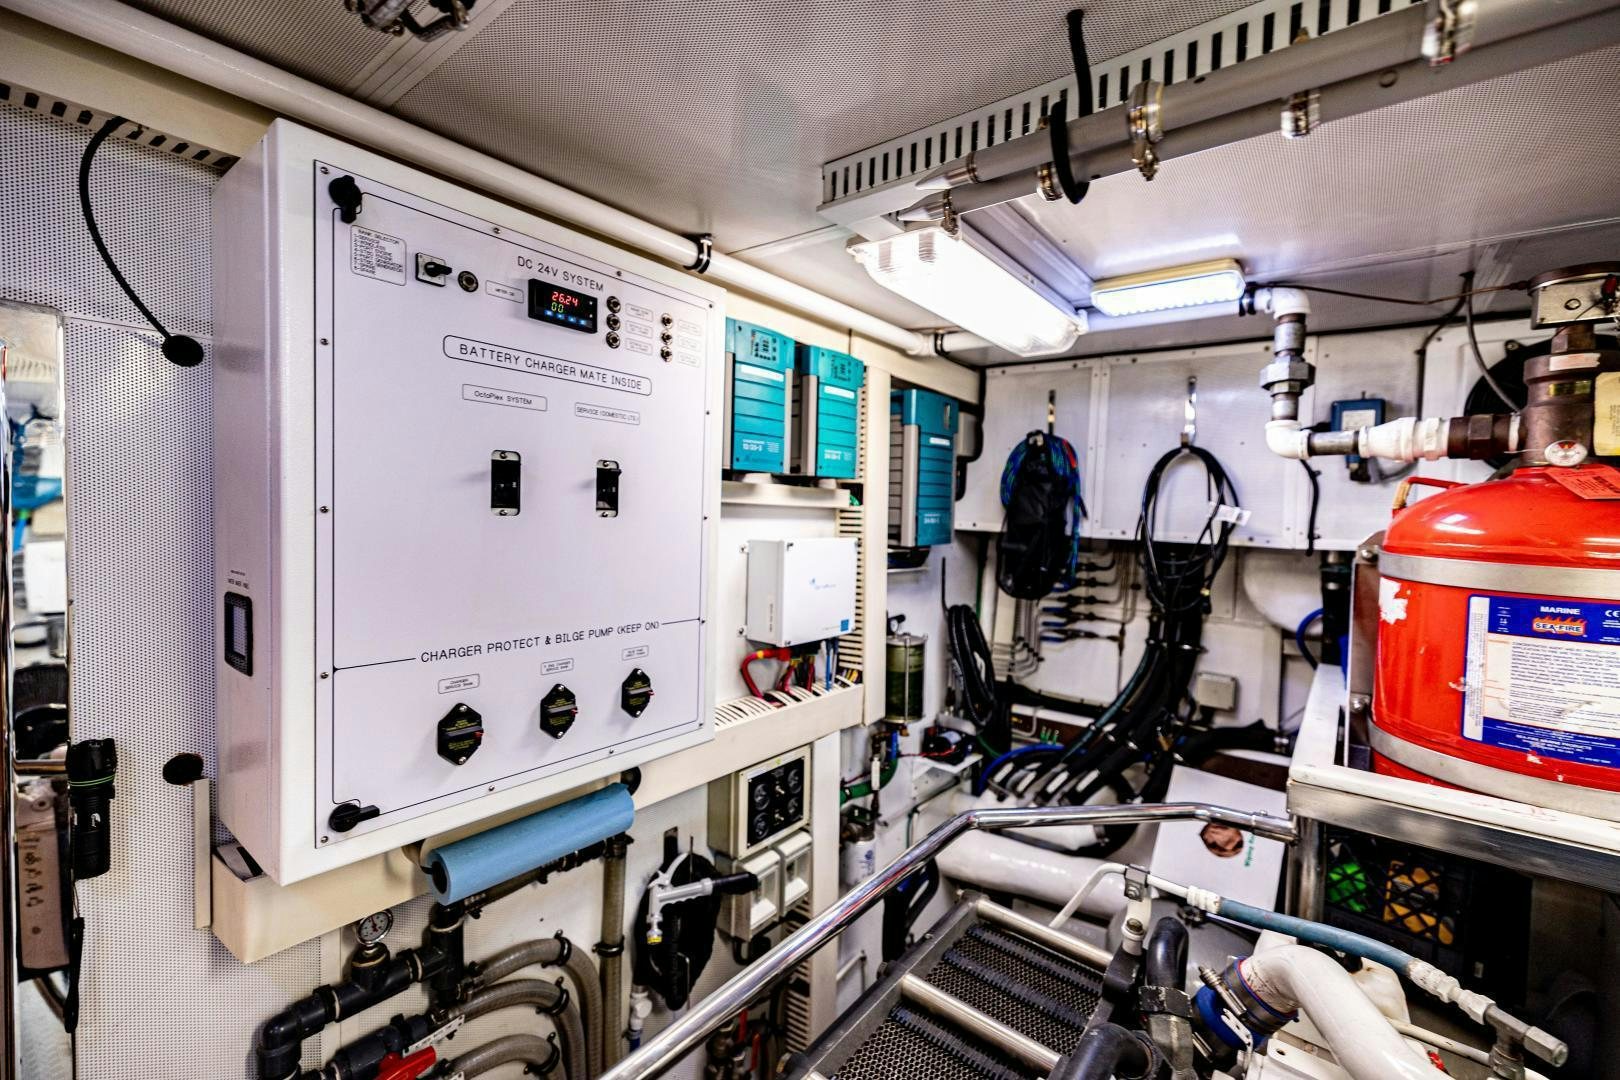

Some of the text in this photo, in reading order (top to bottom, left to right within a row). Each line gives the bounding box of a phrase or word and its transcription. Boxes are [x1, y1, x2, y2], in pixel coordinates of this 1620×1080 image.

[517, 256, 604, 292] DC 24V SYSTEM
[551, 291, 579, 307] 26.24
[459, 343, 642, 391] BATTERY CHARGER MATE INSIDE
[474, 390, 533, 405] OctoPlex SYSTEM
[576, 406, 599, 416] SERVICE
[1540, 606, 1581, 615] MARINE
[1535, 622, 1582, 633] SEA-FIRE
[421, 620, 660, 663] CHARGER PROTECT & BILGE PUMP (KEEP ON)
